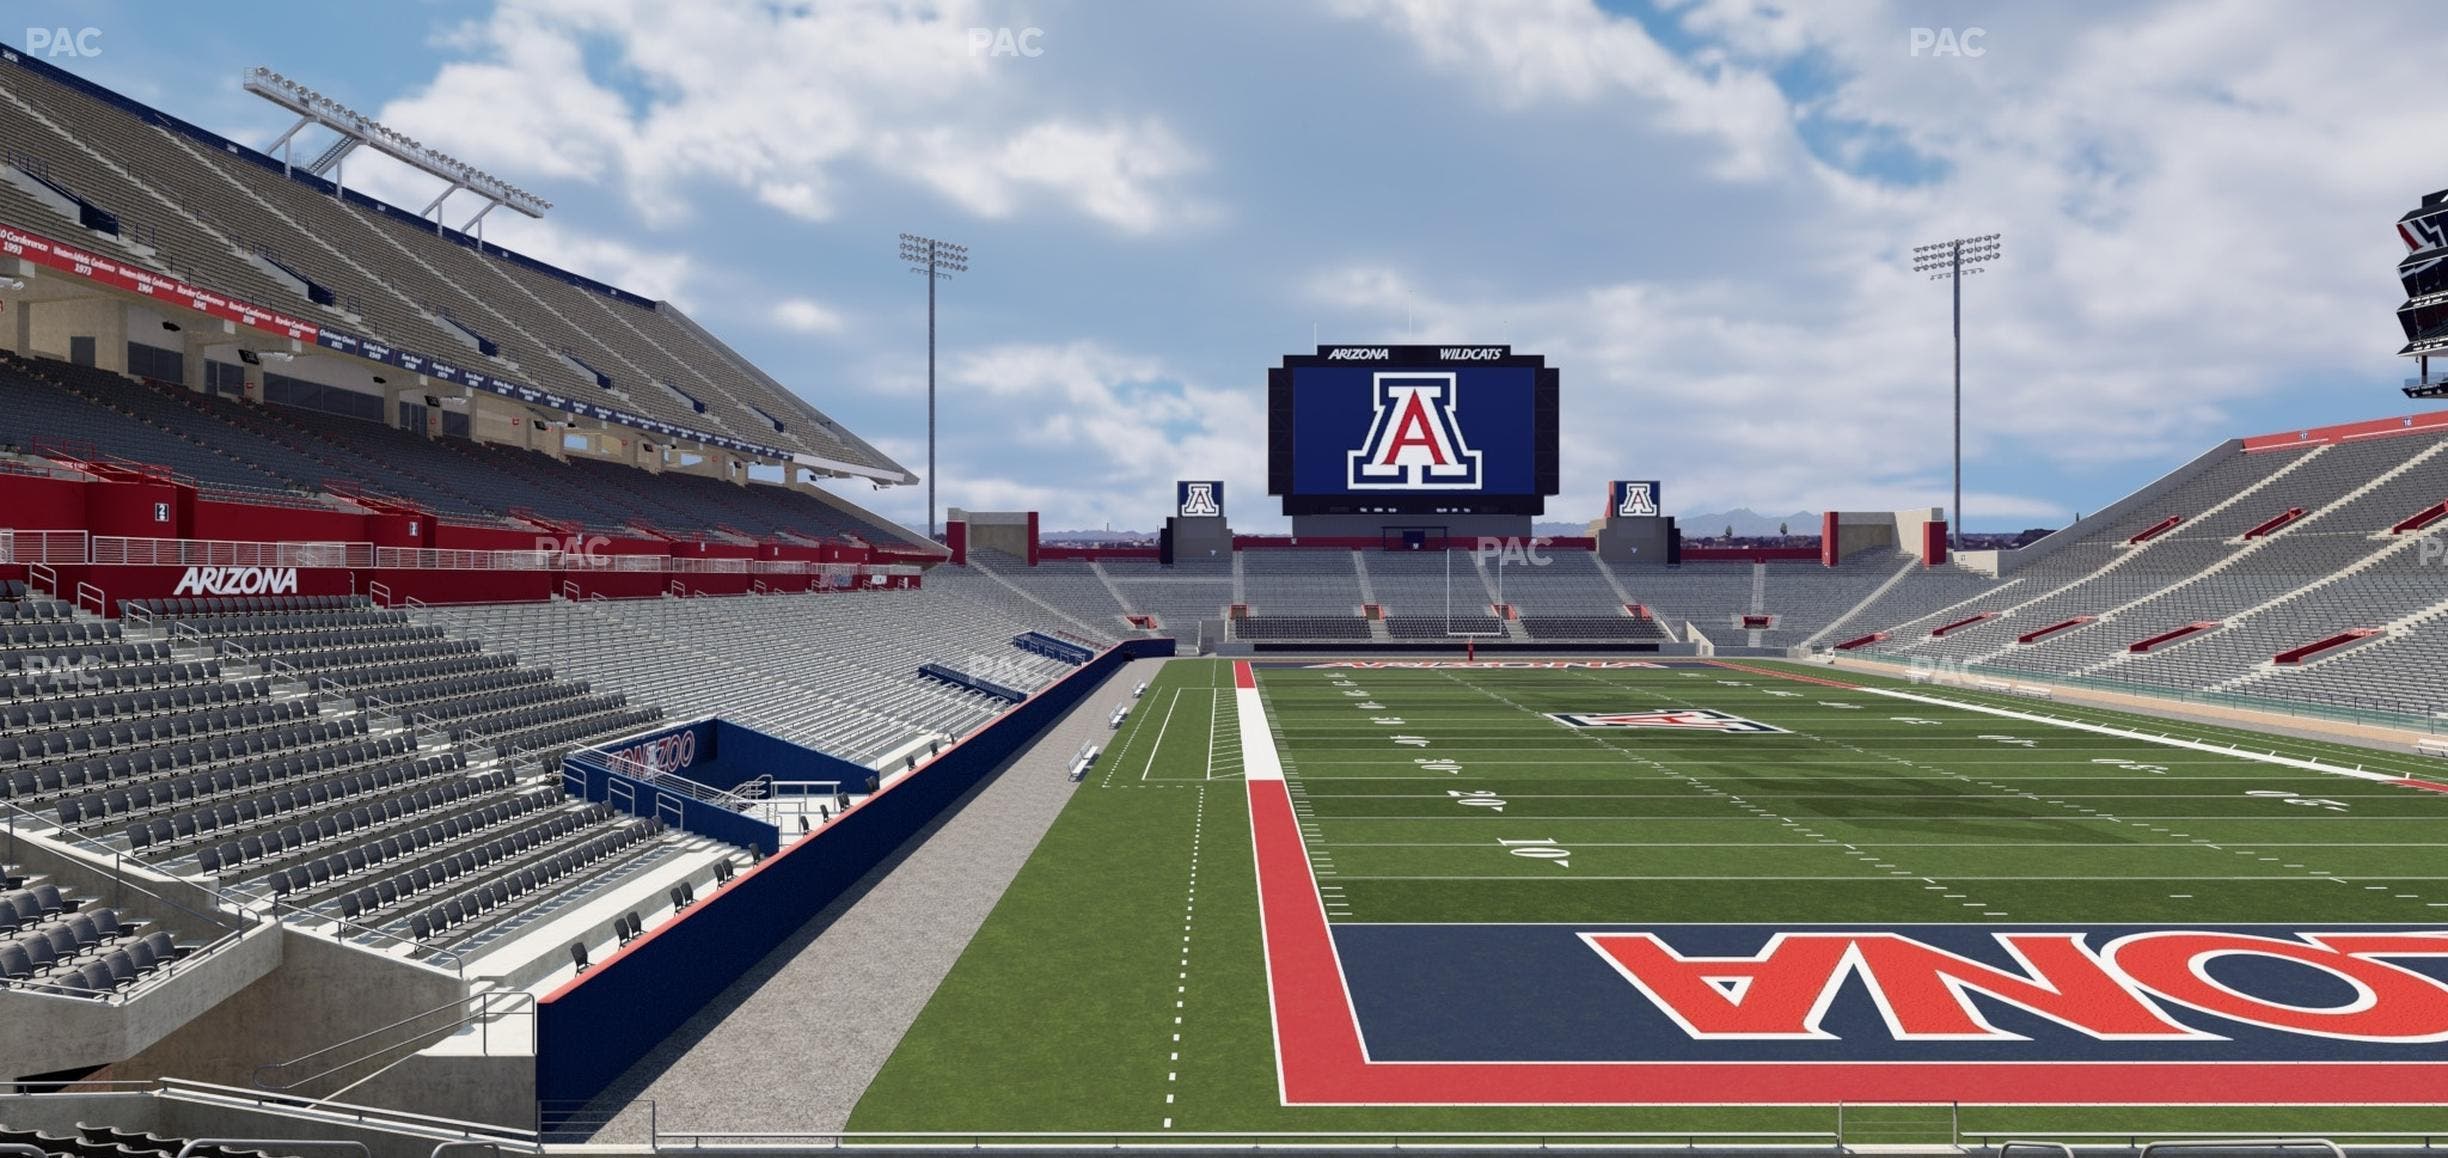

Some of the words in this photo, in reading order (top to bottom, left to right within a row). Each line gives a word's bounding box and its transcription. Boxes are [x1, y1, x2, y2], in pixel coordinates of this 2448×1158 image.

[3, 241, 23, 255] 1993
[1328, 348, 1389, 360] ARIZONA
[1440, 348, 1502, 360] WILDCATS
[1347, 371, 1483, 490] A
[173, 566, 297, 596] ARIZONA
[1446, 789, 1507, 807] 20
[1496, 837, 1572, 858] 10
